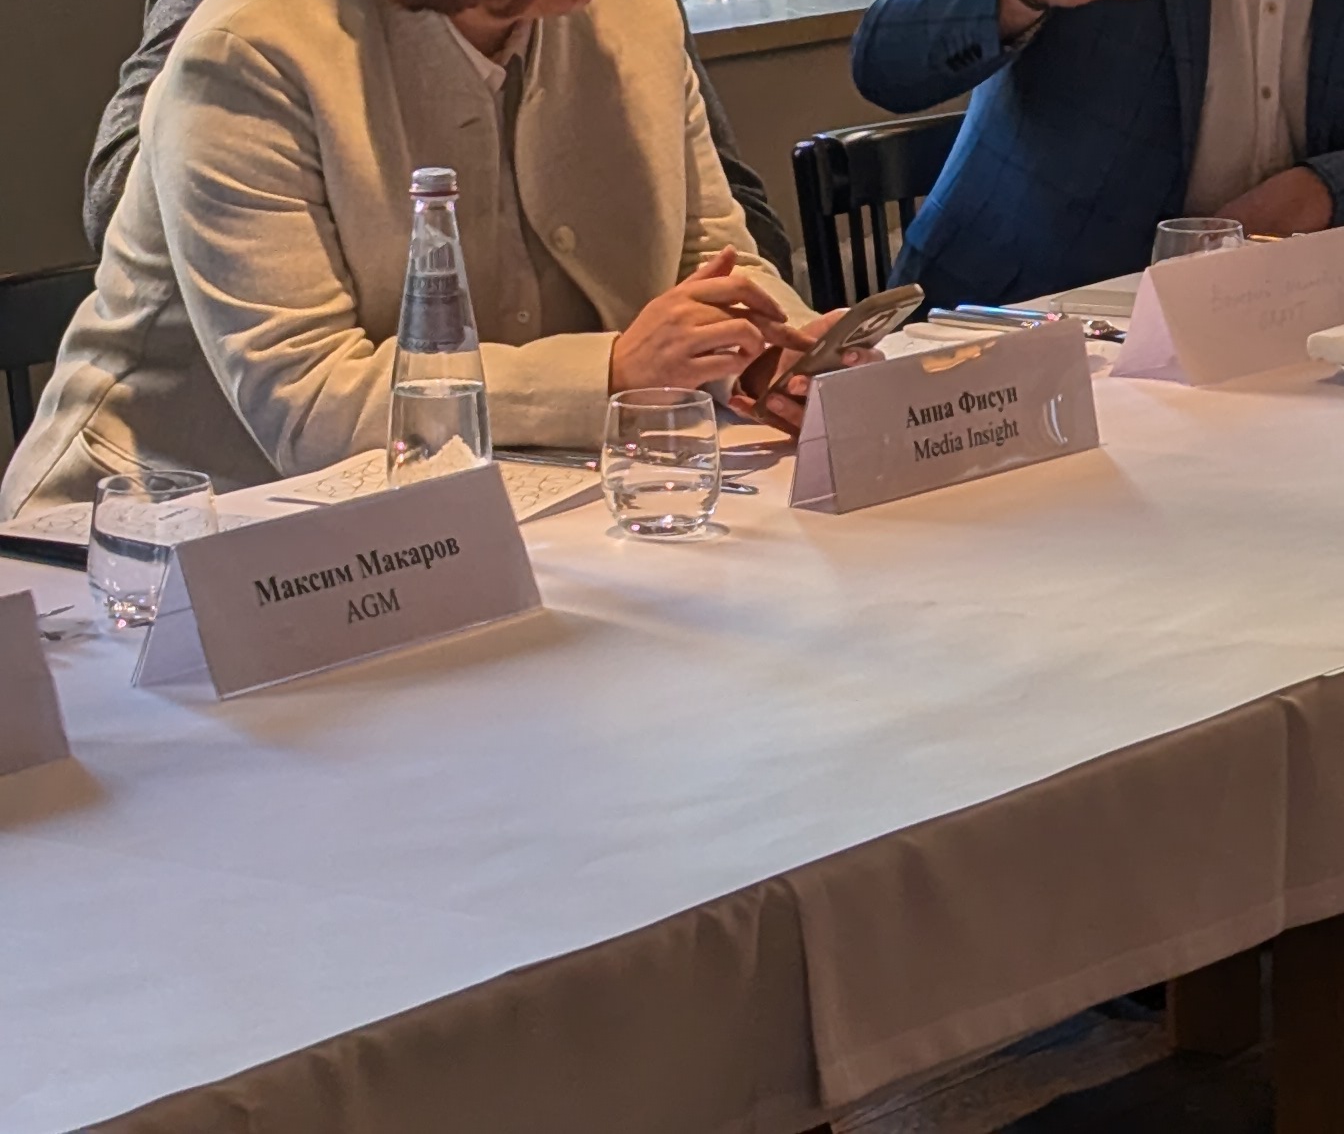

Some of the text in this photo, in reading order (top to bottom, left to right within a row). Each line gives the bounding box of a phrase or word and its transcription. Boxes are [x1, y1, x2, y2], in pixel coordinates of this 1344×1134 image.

[905, 386, 1018, 429] Анна Фисун
[913, 417, 1019, 462] Media Insight
[253, 537, 460, 608] Максим Макаров
[347, 587, 401, 624] AGM
